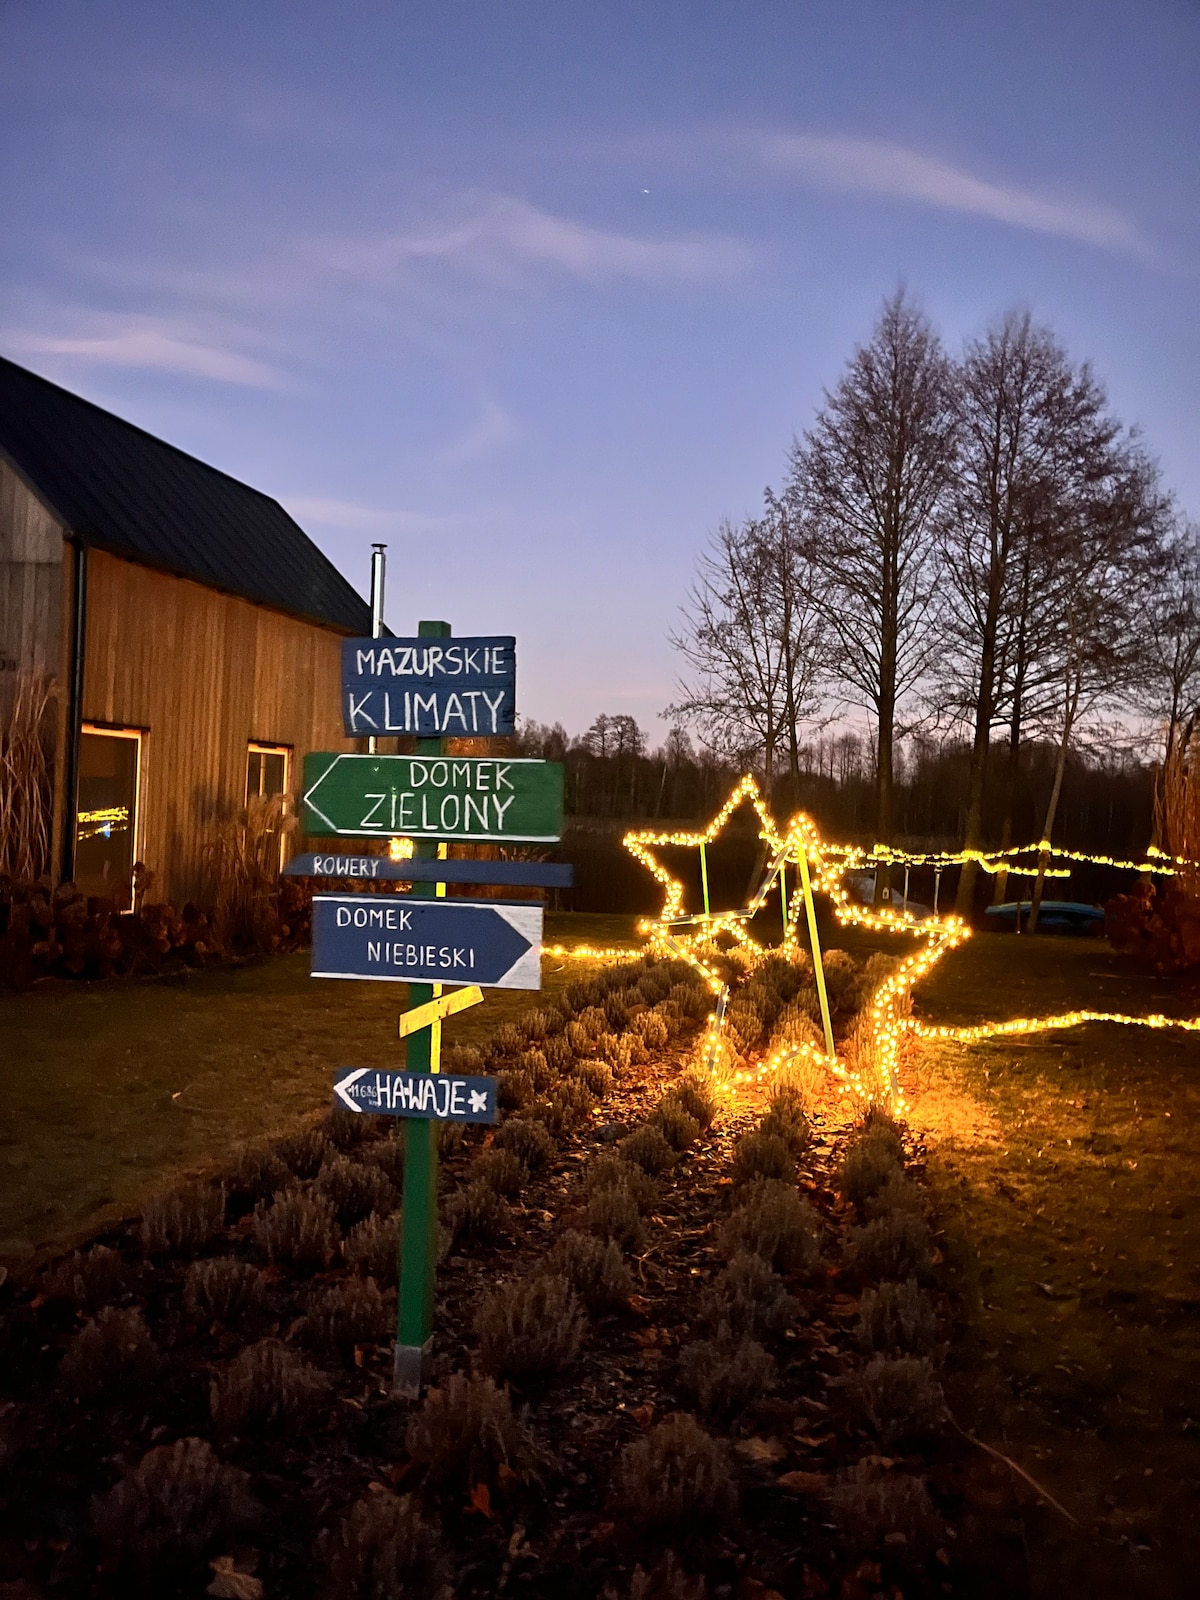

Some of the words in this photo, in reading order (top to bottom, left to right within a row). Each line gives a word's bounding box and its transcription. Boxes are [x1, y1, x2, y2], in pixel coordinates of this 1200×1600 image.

[356, 646, 508, 677] MAZURSKIE
[348, 691, 506, 733] KLIMATY
[410, 761, 515, 790] DOMEK
[360, 791, 516, 831] ZIELONY
[313, 856, 380, 878] ROWERY
[336, 907, 413, 930] DOMEK
[367, 941, 475, 968] NIEBIESKI
[376, 1073, 466, 1117] HAWAJE
